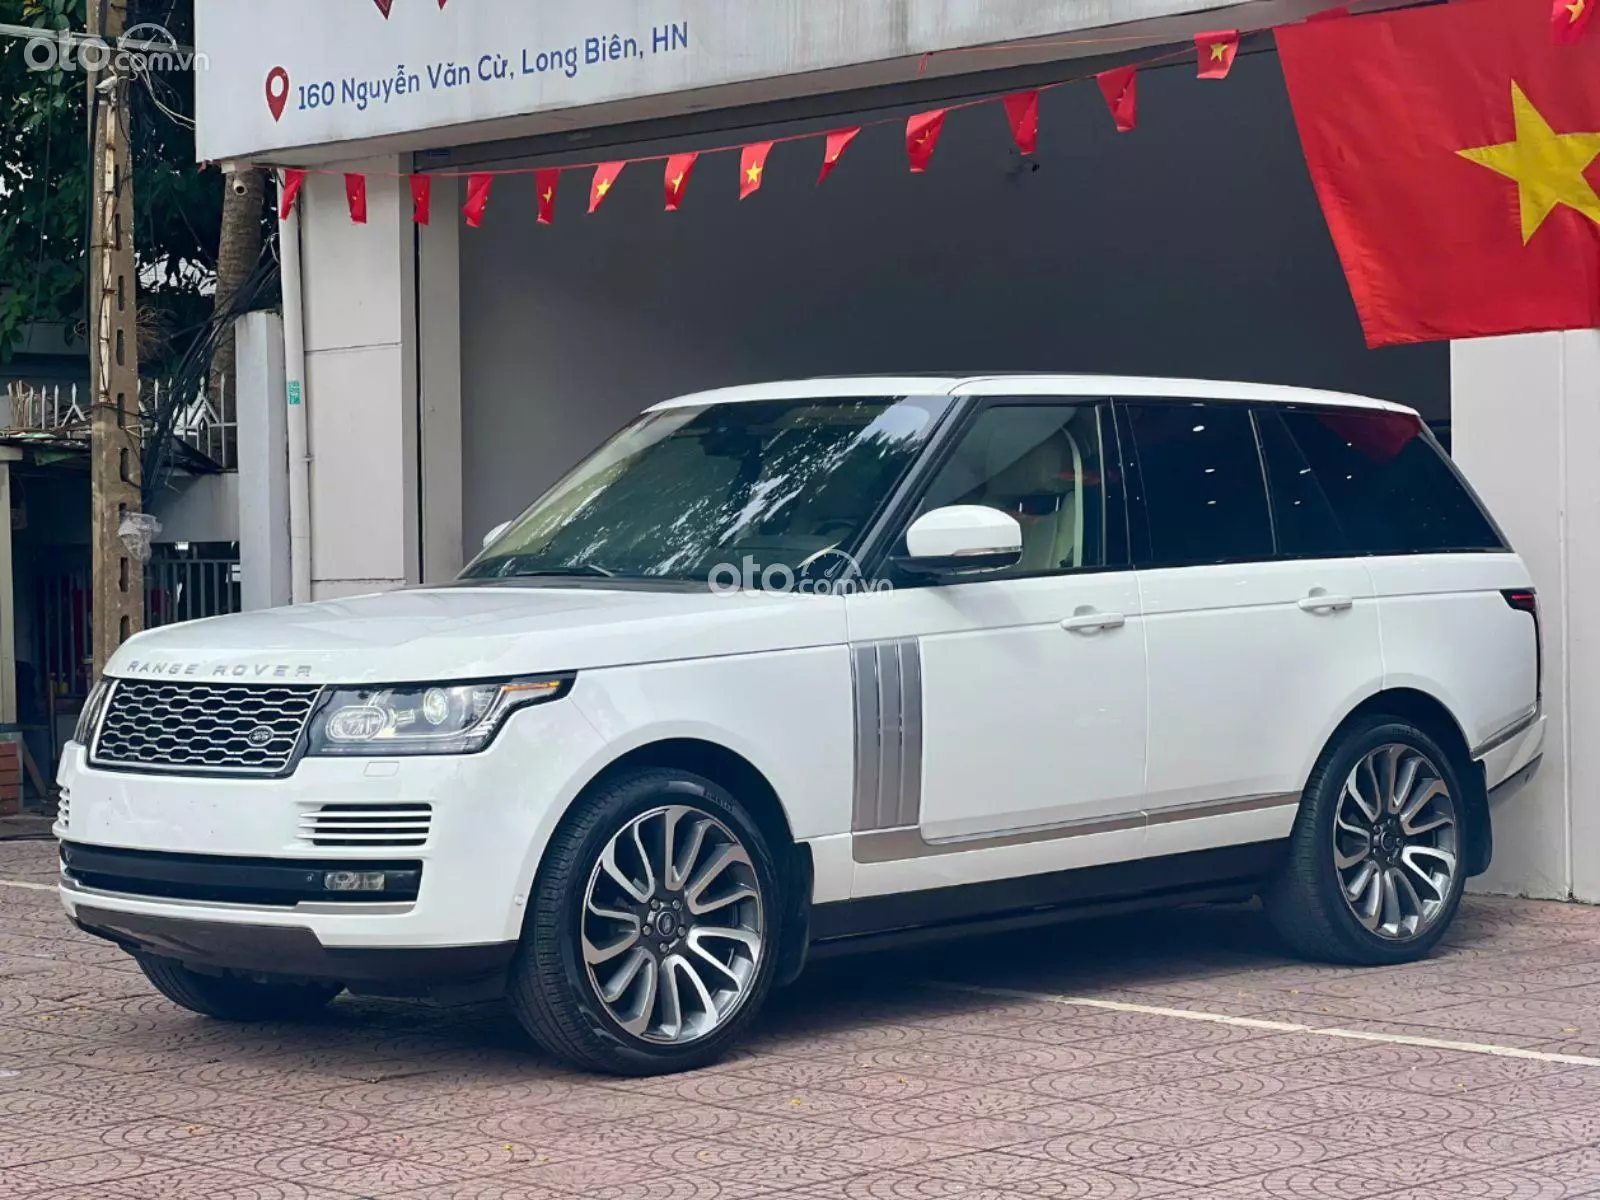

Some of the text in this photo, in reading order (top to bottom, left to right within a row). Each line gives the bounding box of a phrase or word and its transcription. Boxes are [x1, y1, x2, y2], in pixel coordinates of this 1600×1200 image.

[298, 21, 688, 110] 160 Nguyễn Văn Cừ, Long Biên, HN
[126, 660, 312, 678] RANGE ROVER
